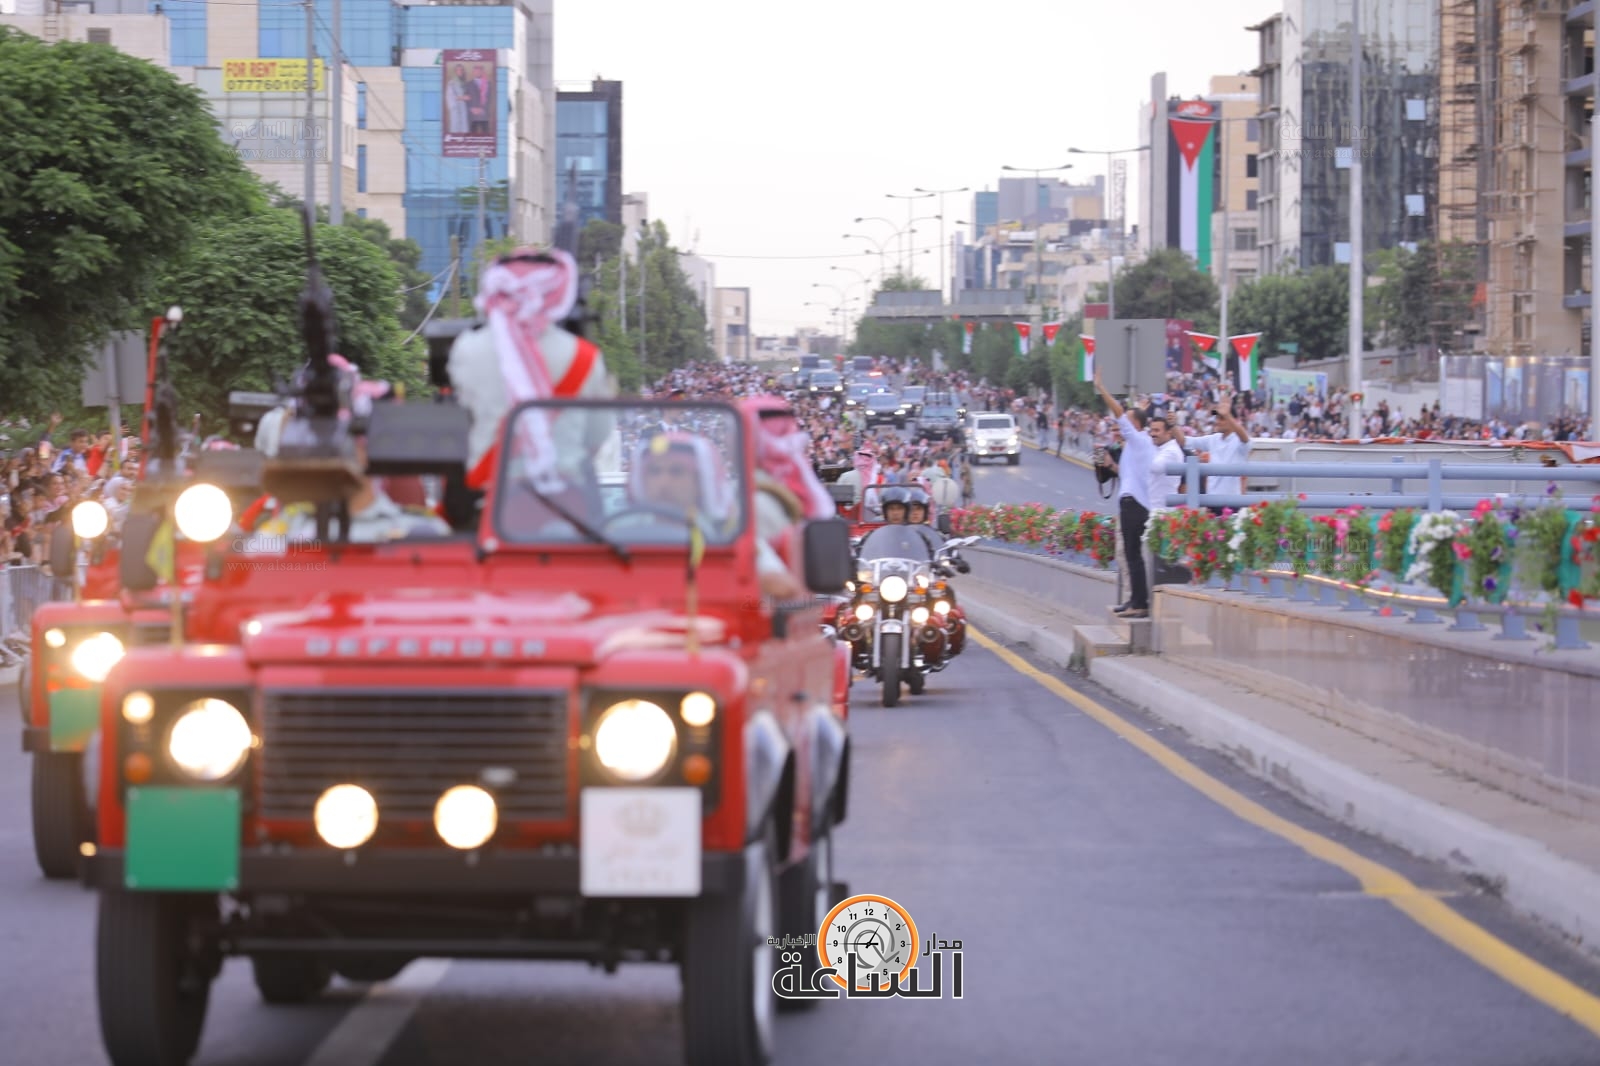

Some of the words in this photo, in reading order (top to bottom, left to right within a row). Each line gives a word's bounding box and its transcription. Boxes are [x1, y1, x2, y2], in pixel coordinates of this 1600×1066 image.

[226, 62, 246, 78] FOR
[250, 62, 277, 78] RENT
[304, 636, 547, 657] DEFENDER
